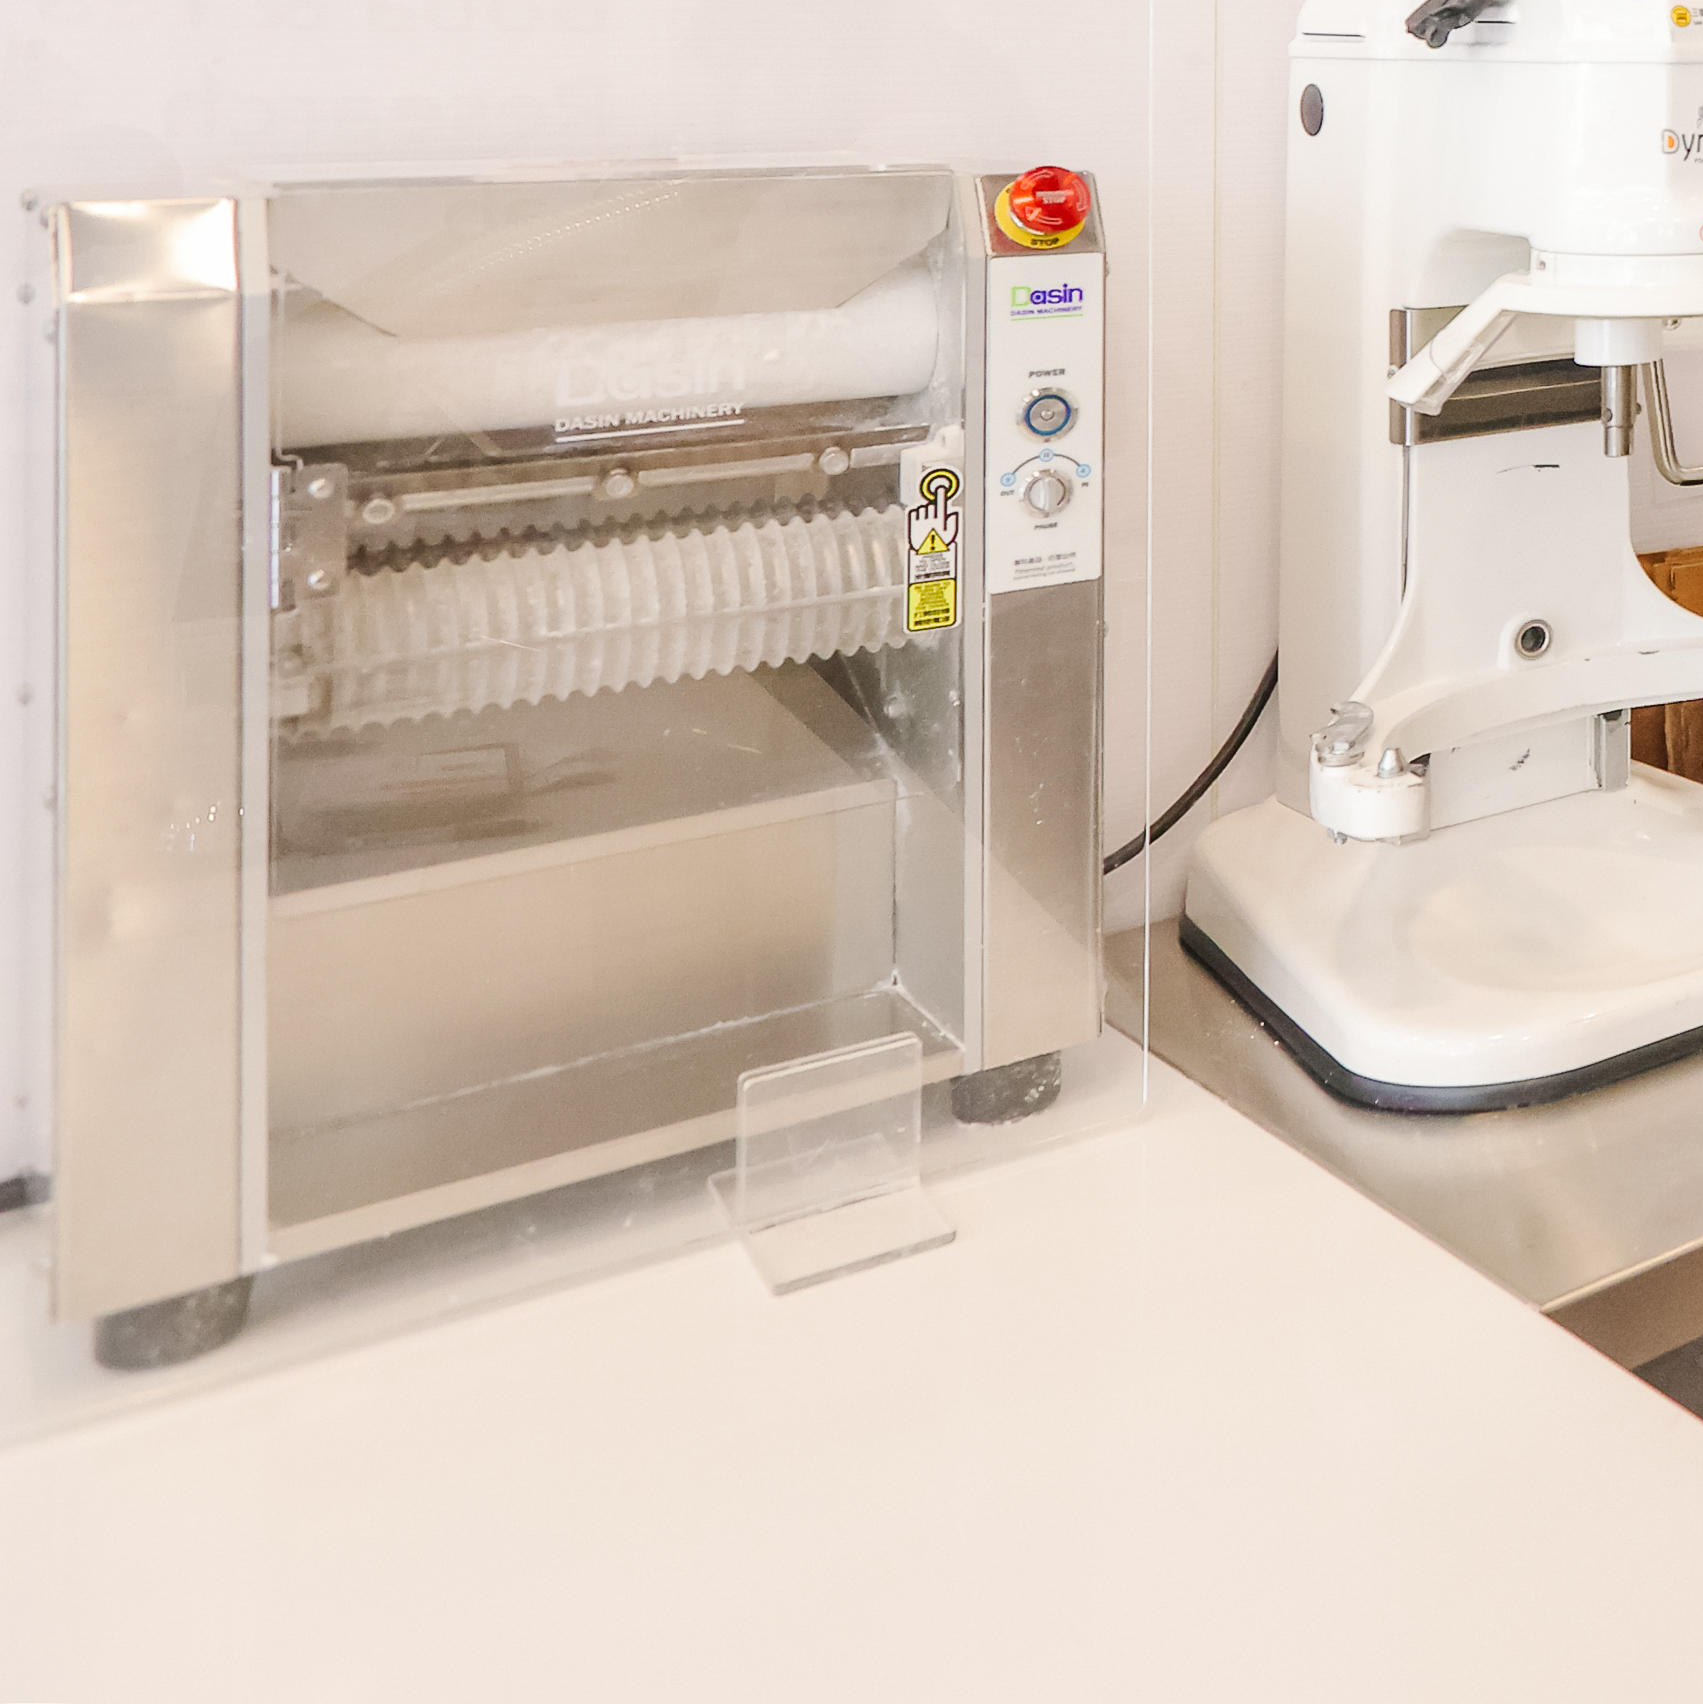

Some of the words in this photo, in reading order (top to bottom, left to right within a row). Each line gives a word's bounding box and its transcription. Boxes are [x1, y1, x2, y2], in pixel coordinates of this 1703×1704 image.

[1030, 237, 1060, 247] STOP
[1011, 283, 1083, 307] Dasin
[555, 358, 746, 407] Dasin
[1028, 368, 1066, 379] POWER
[554, 415, 620, 433] DASIN
[626, 401, 745, 426] MACHINERY
